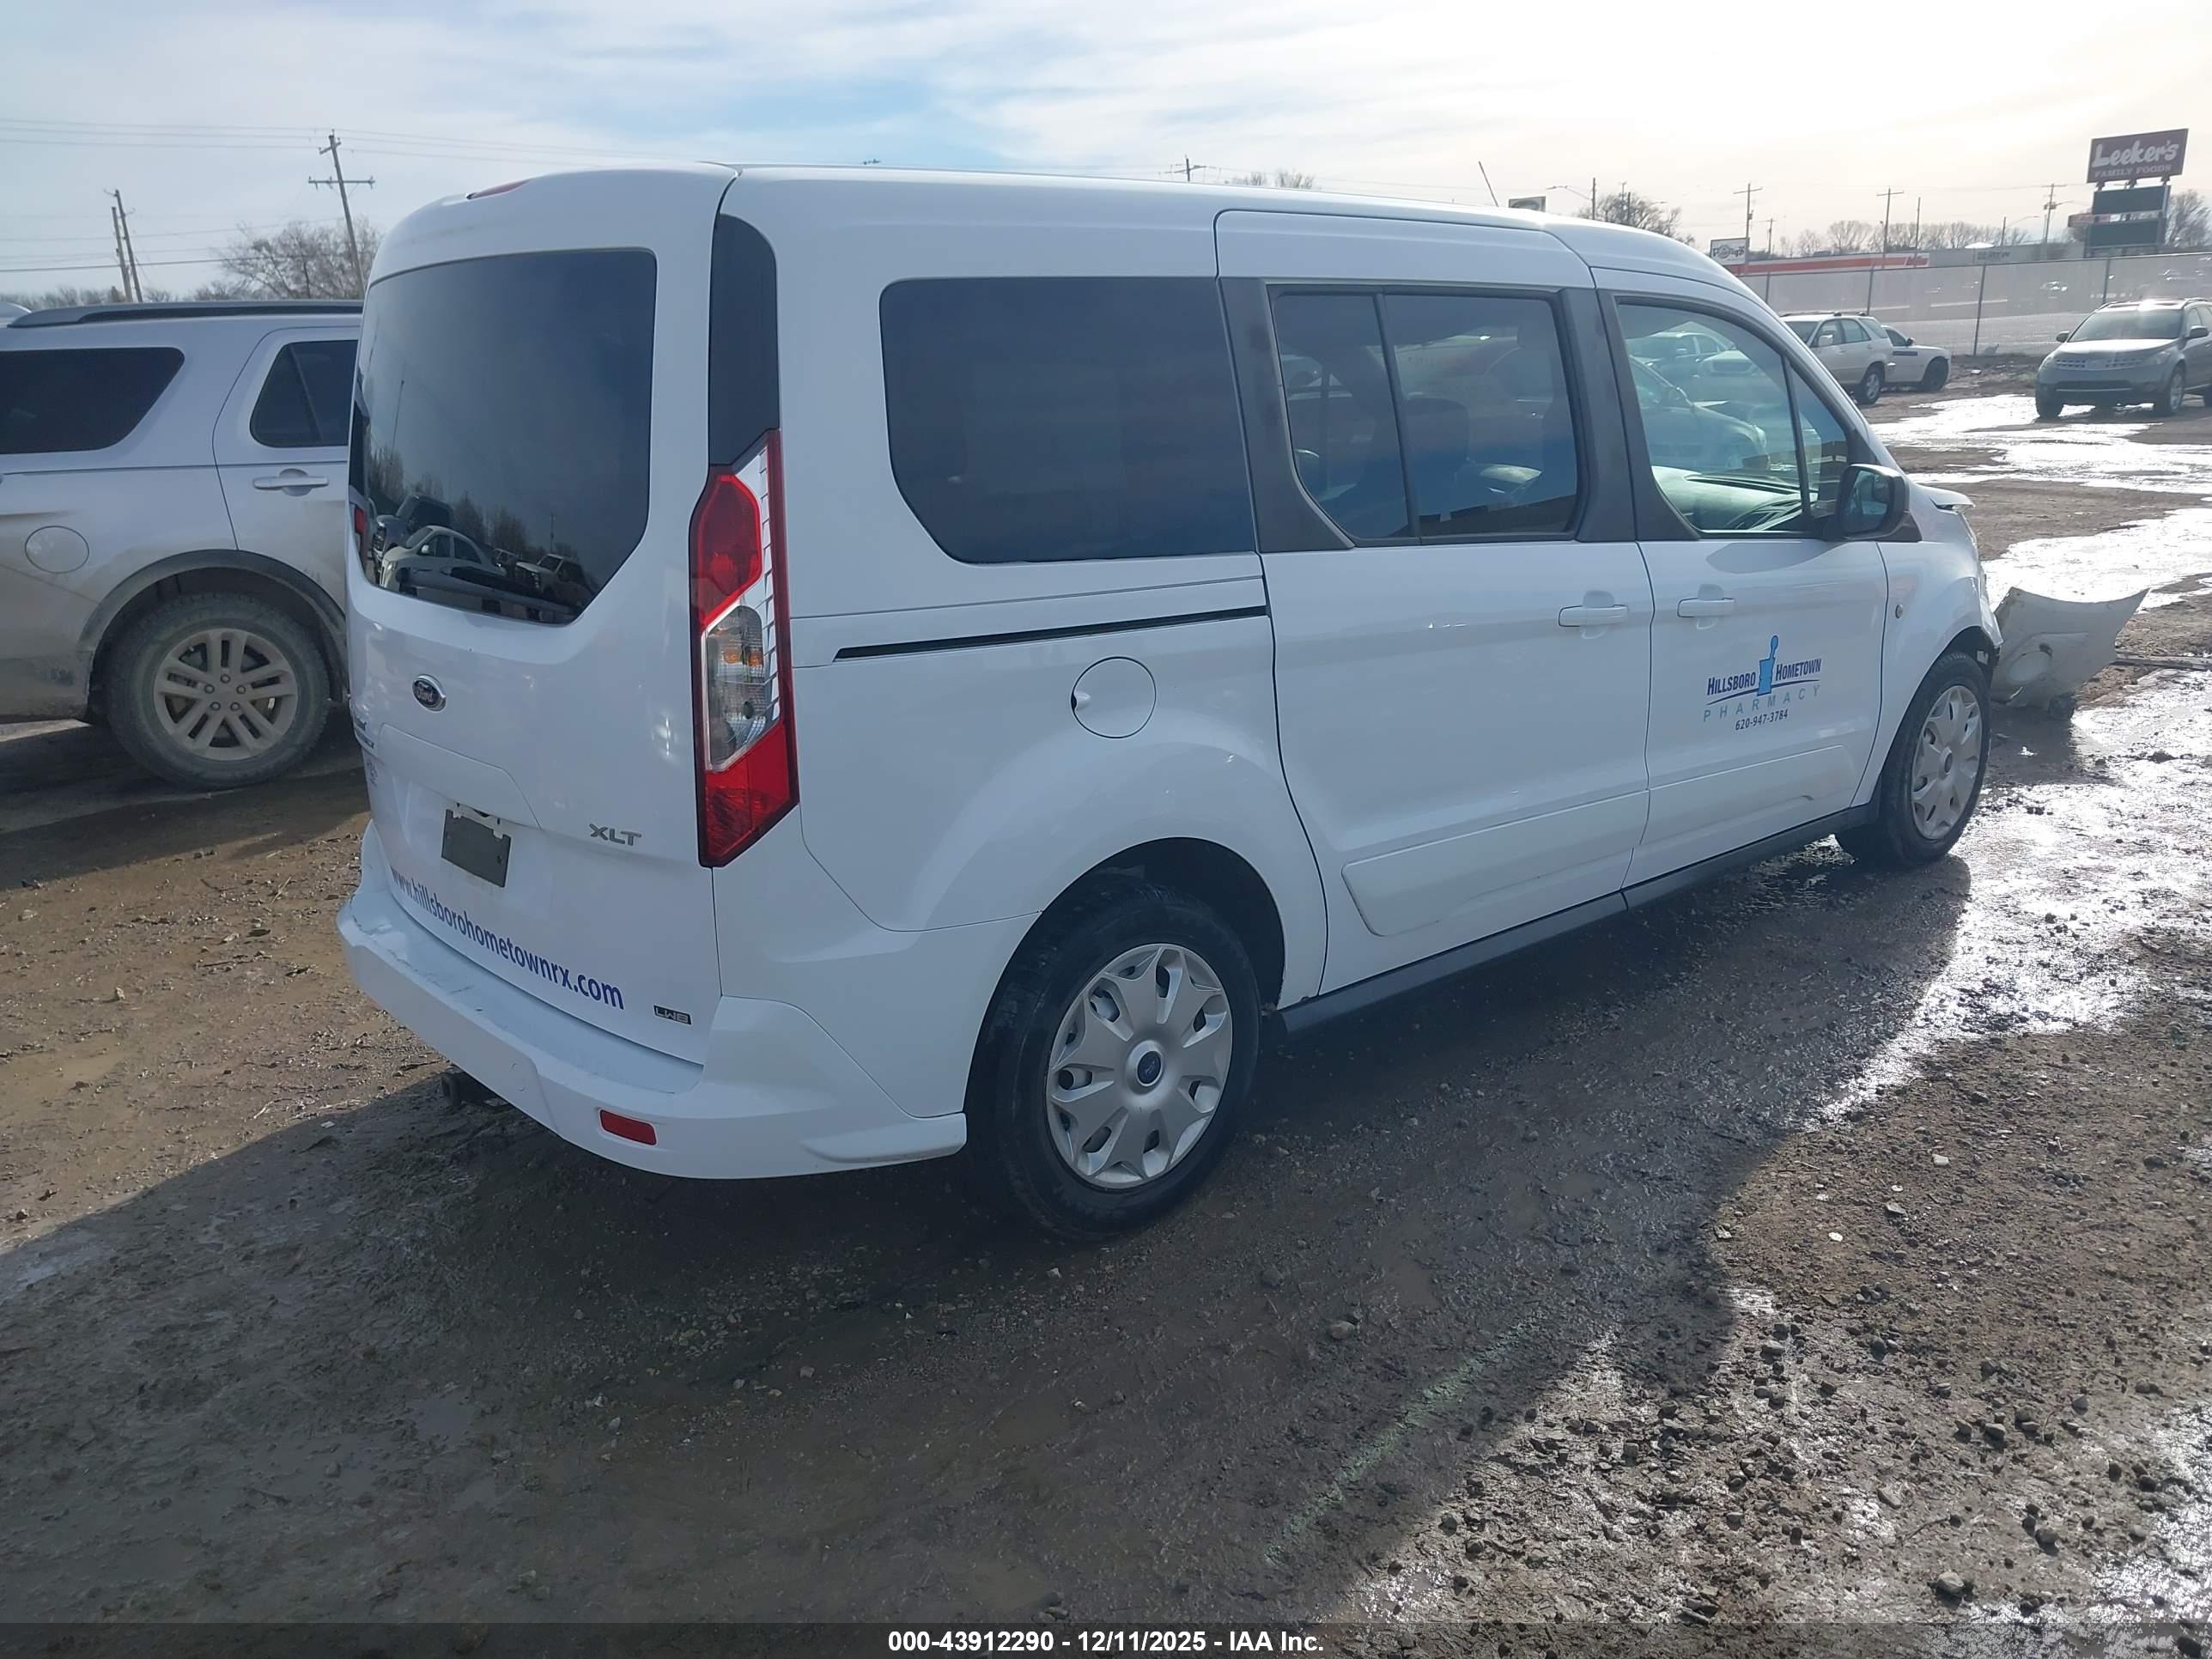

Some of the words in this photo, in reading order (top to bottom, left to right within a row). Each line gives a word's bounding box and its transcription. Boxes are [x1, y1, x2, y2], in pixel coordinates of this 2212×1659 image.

[2092, 140, 2179, 167] Leeker's
[2094, 168, 2133, 178] FAMILY
[2136, 164, 2172, 174] FOODS
[1707, 672, 1756, 696] HILLSBORO
[1775, 658, 1822, 681] HOMETOWN
[1704, 684, 1820, 722] PHARMACY
[1735, 708, 1789, 731] 620-947-3784
[589, 823, 642, 846] XLT
[654, 1006, 690, 1024] LWB
